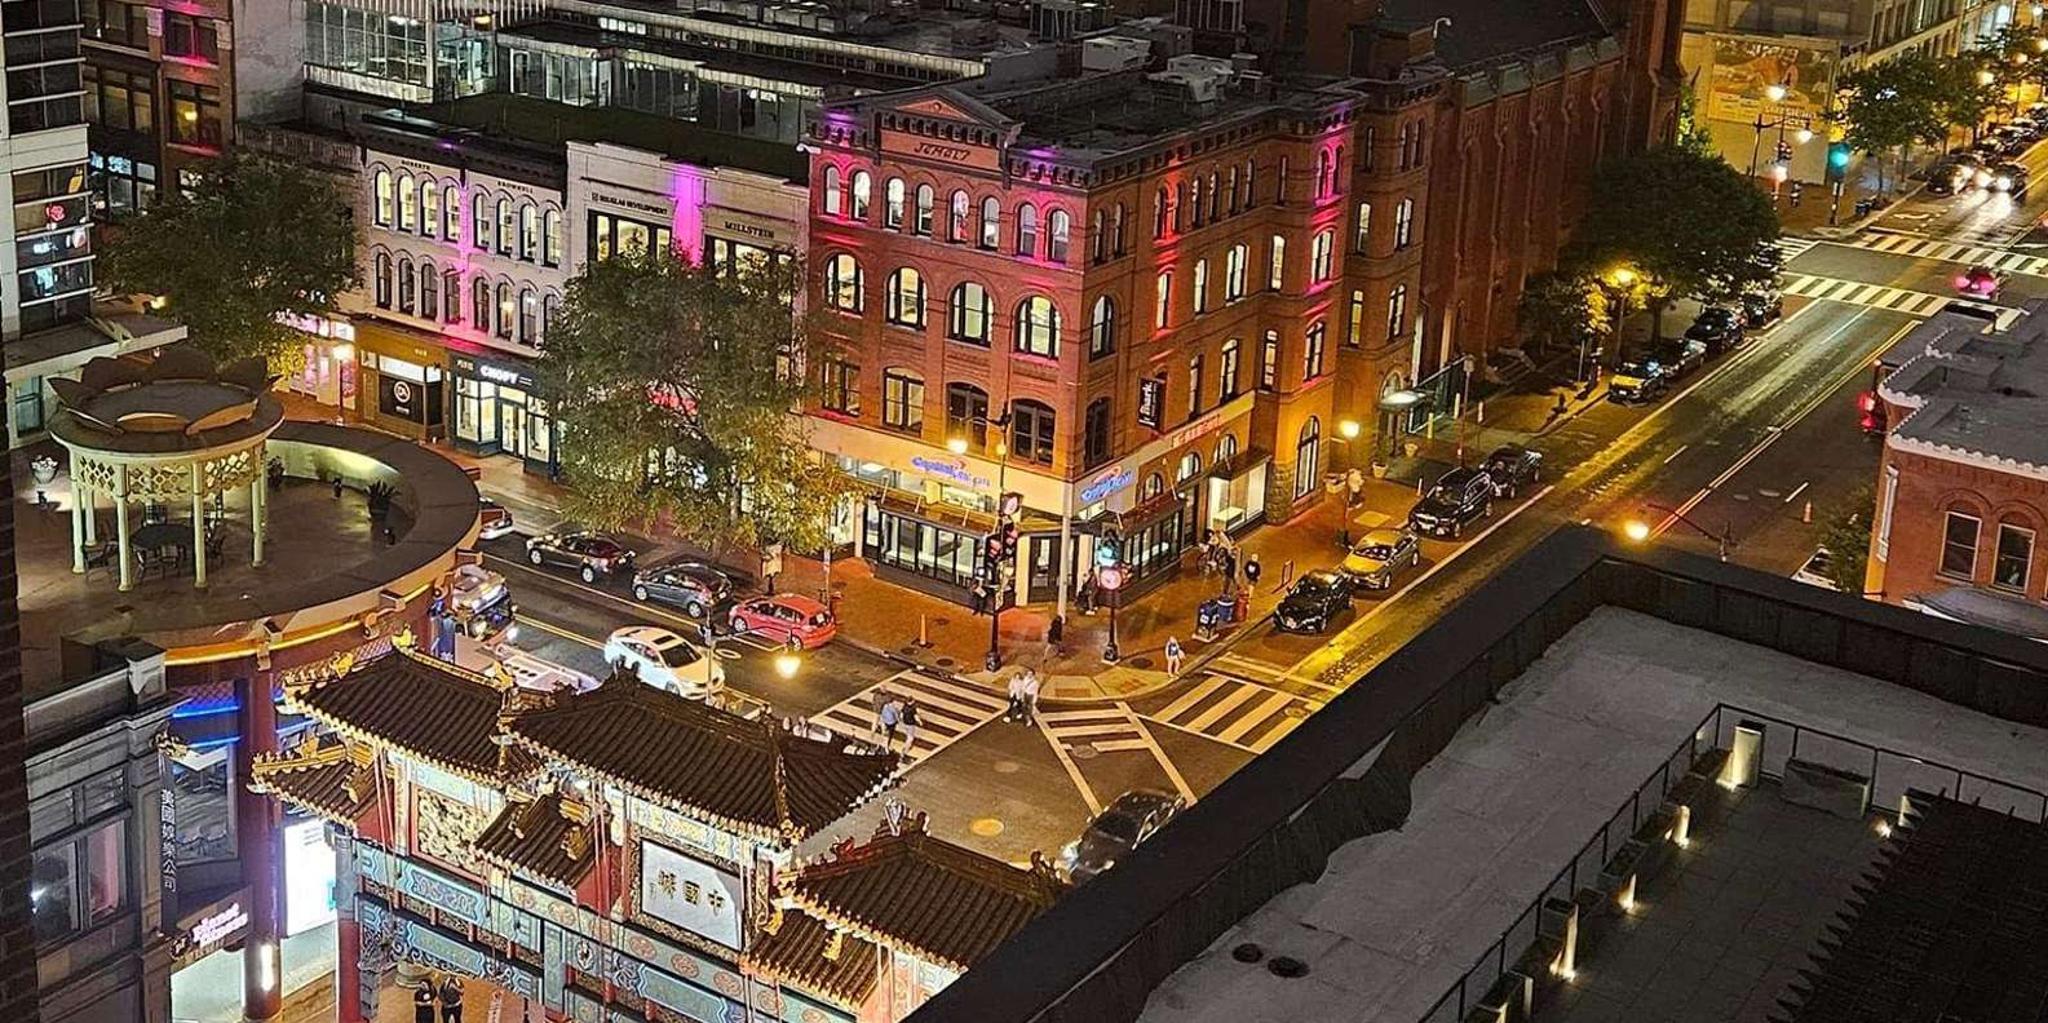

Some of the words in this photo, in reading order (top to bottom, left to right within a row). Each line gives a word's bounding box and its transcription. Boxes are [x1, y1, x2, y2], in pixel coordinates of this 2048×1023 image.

[626, 200, 668, 215] DEVELOPMENT
[724, 221, 775, 239] MILLSTEIN
[912, 457, 955, 478] Capital
